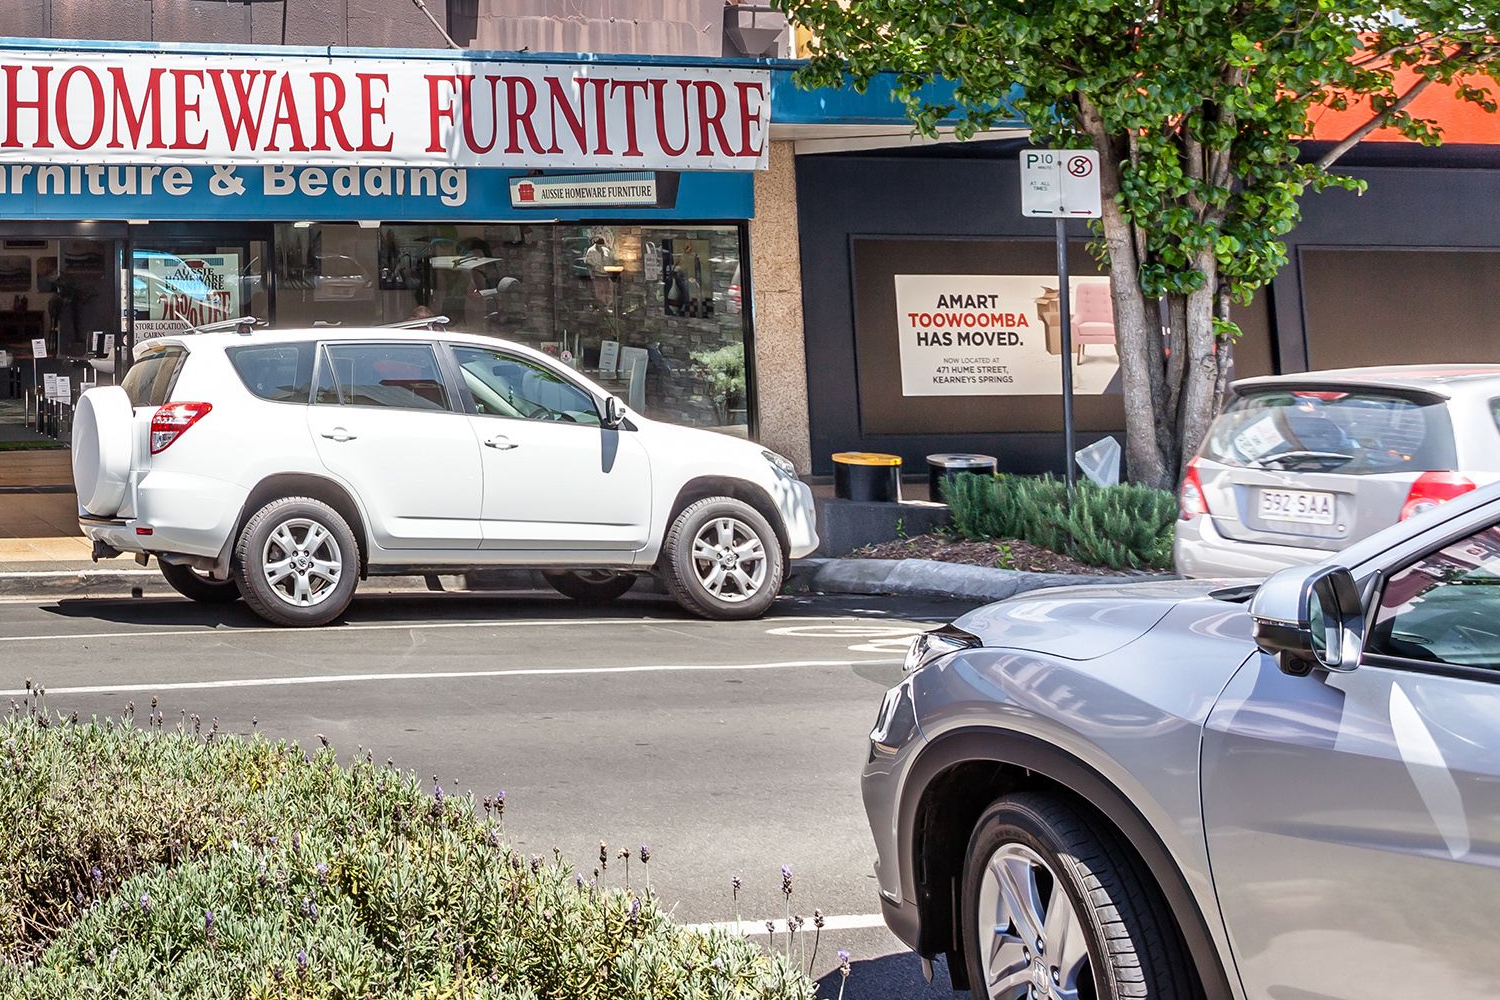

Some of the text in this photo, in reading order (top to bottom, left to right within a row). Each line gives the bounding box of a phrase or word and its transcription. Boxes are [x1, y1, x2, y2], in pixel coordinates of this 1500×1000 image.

[0, 64, 394, 154] HOMEWARE
[423, 73, 767, 158] FURNITURE
[263, 166, 468, 207] Bedding
[541, 185, 652, 200] AUSSIE HOMEWARE FURNITURE
[936, 294, 999, 309] AMART
[135, 322, 155, 330] STORE
[907, 313, 1029, 328] TOOWOOMBA
[916, 332, 1024, 347] HAS MOVED.
[936, 366, 1009, 375] 471 HUME STREET,
[932, 375, 1014, 384] KEARNEYS SPRINGS
